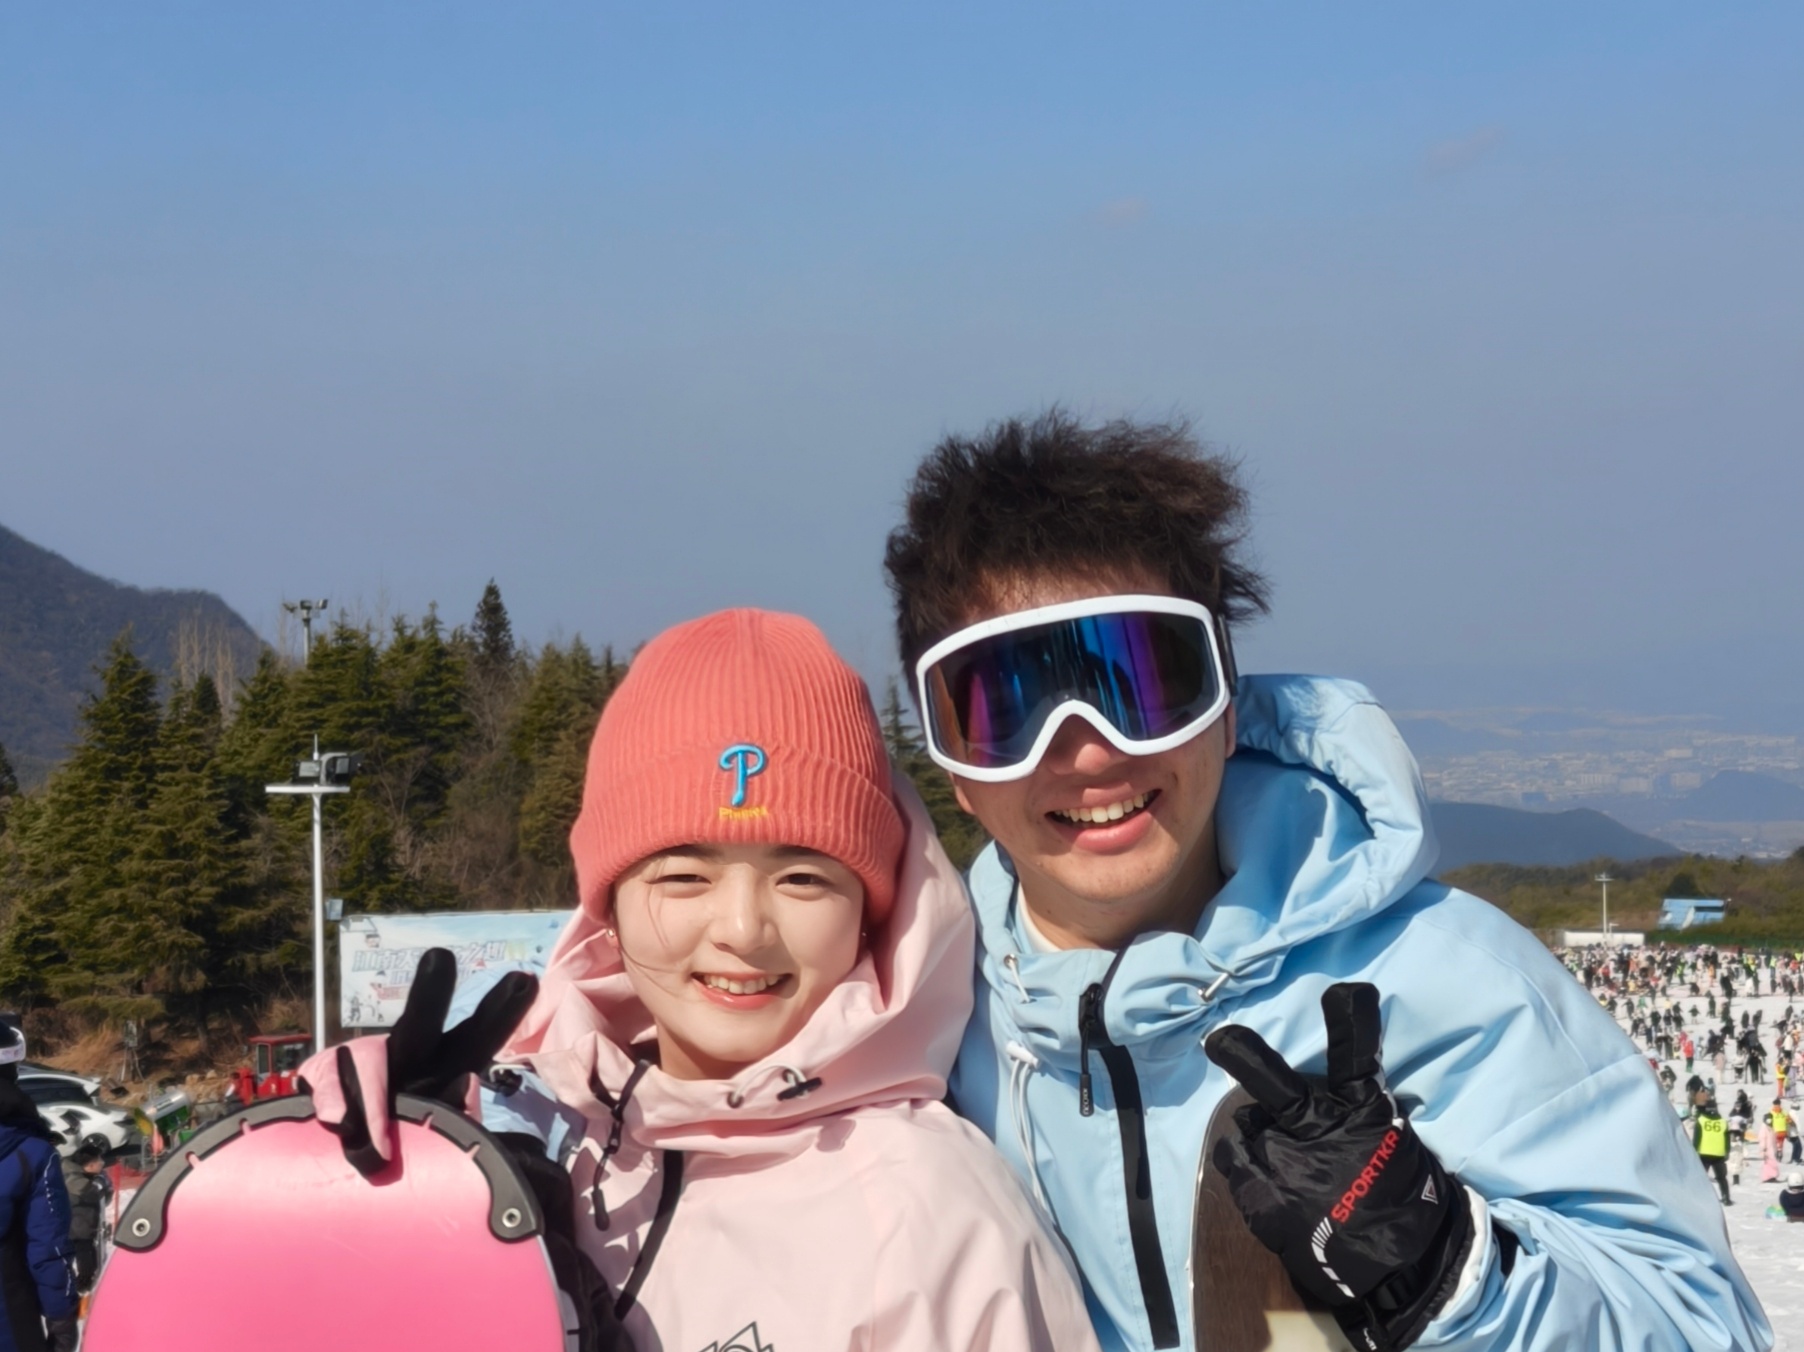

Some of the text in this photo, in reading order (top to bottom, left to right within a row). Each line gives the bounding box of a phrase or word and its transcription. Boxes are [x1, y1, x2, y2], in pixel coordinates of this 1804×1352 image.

[719, 743, 767, 806] P
[1704, 1120, 1722, 1133] 66
[1331, 1129, 1400, 1223] SPORTKR
